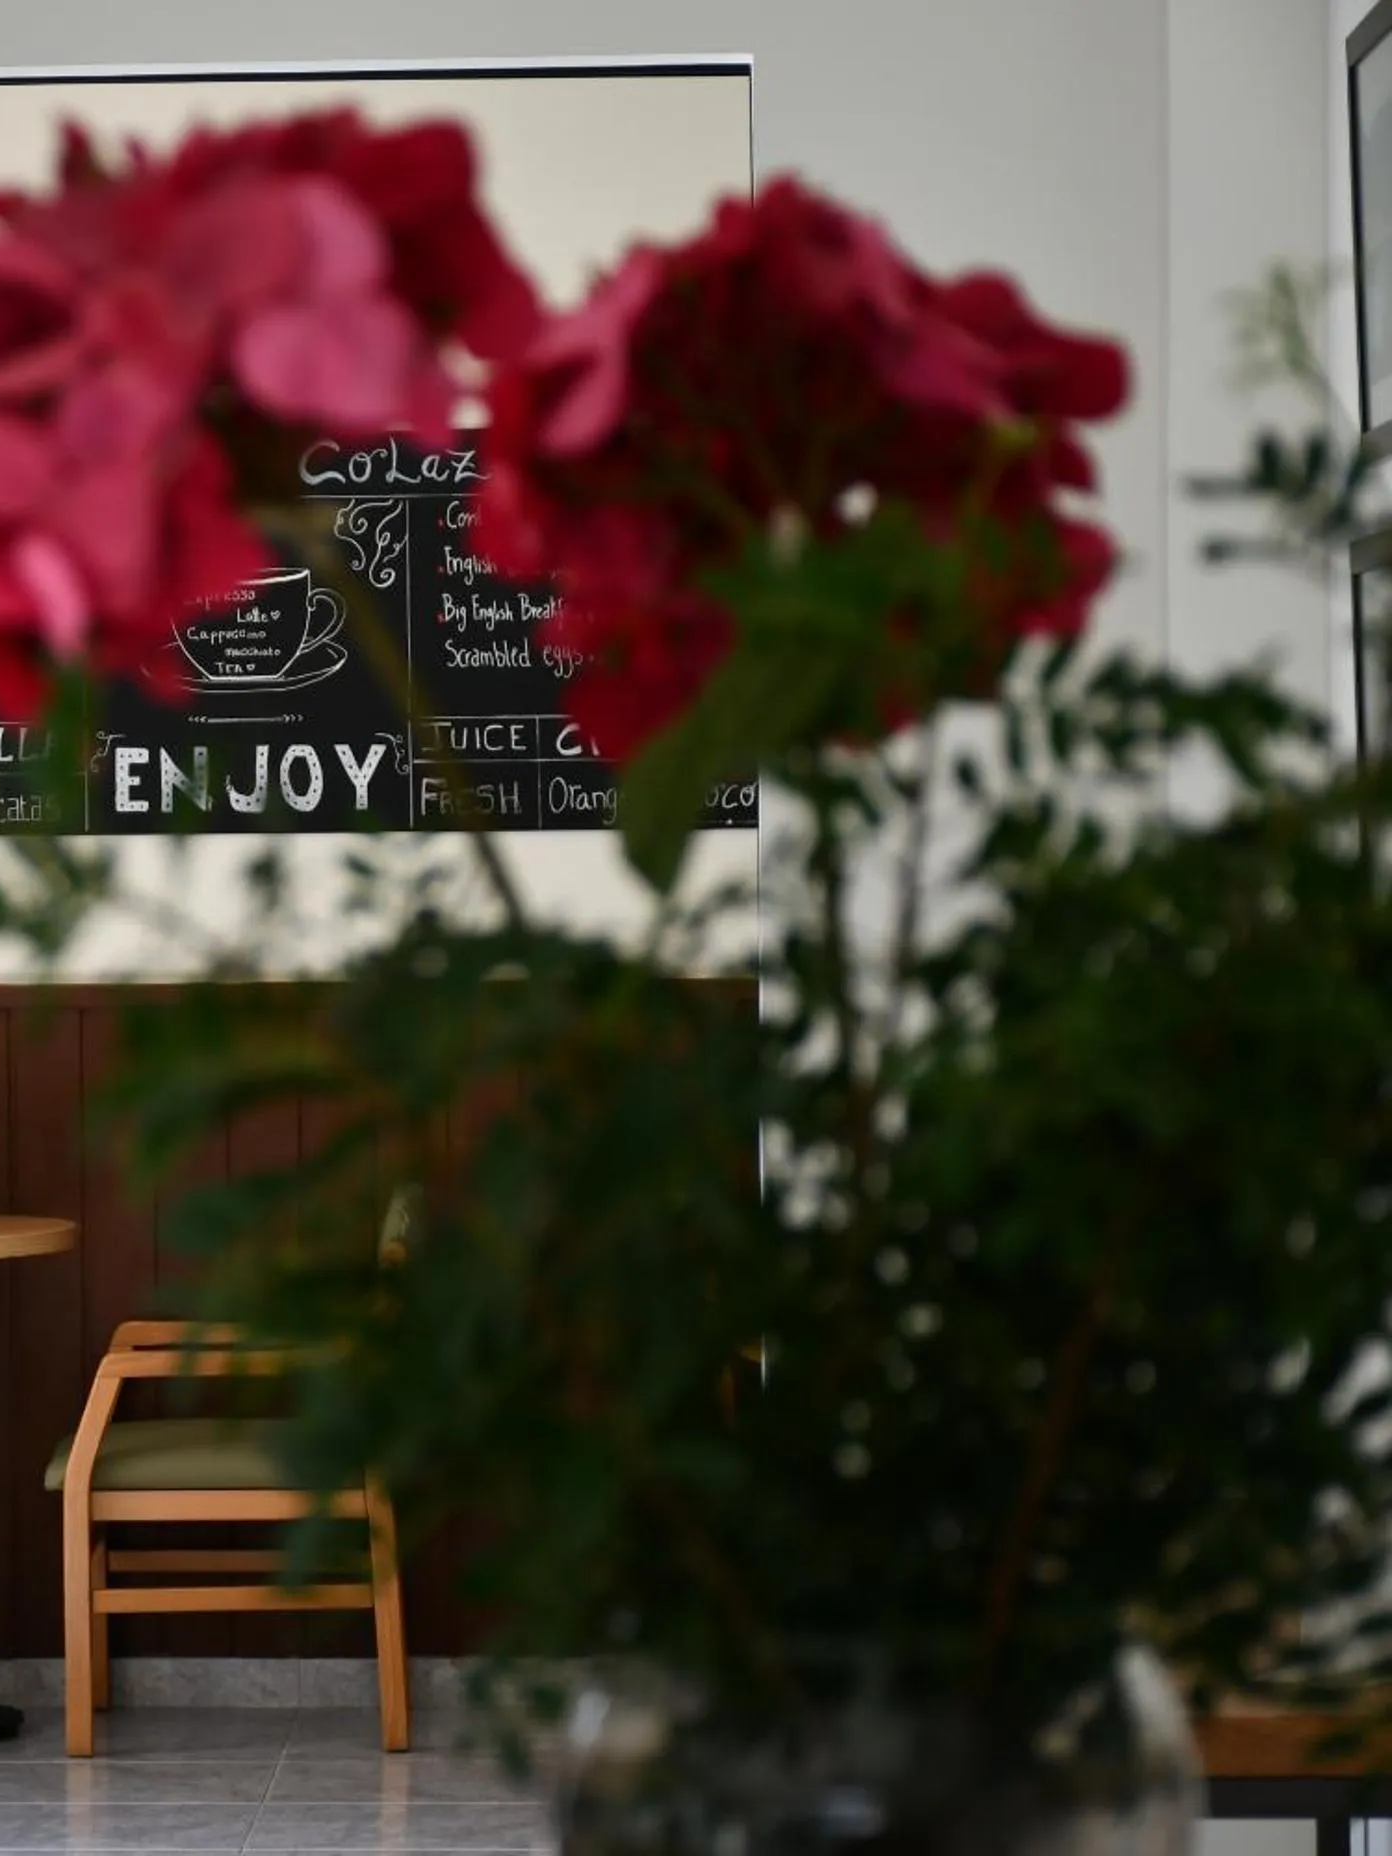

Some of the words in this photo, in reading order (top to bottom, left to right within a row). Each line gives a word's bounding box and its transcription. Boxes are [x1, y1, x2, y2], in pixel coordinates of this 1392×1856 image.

[444, 545, 498, 585] English
[442, 593, 467, 632] Big
[472, 594, 514, 631] English
[444, 637, 532, 669] Scrambled
[421, 721, 527, 751] JUICE
[114, 744, 387, 814] ENJOY
[549, 777, 618, 825] Orang
